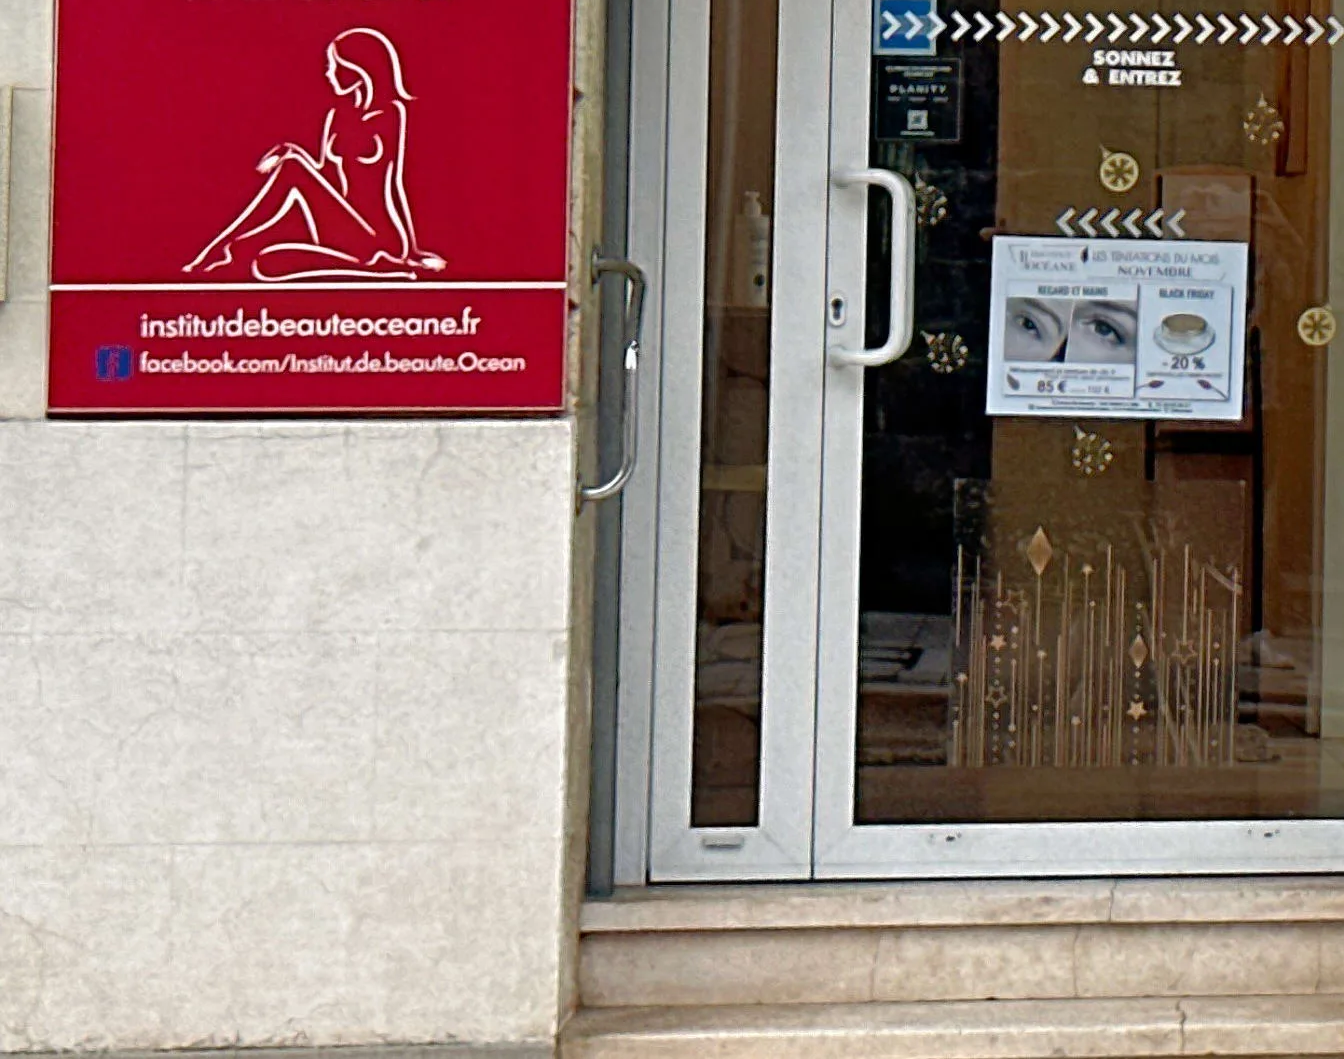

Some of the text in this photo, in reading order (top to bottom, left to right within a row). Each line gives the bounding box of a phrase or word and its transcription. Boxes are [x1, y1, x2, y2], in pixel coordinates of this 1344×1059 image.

[1094, 50, 1176, 68] SONNEZ
[1083, 68, 1182, 87] & ENTREZ
[1118, 266, 1193, 278] NOVEMBRE
[140, 308, 481, 338] institutdebeauteoceane.fr
[1170, 356, 1189, 371] 20
